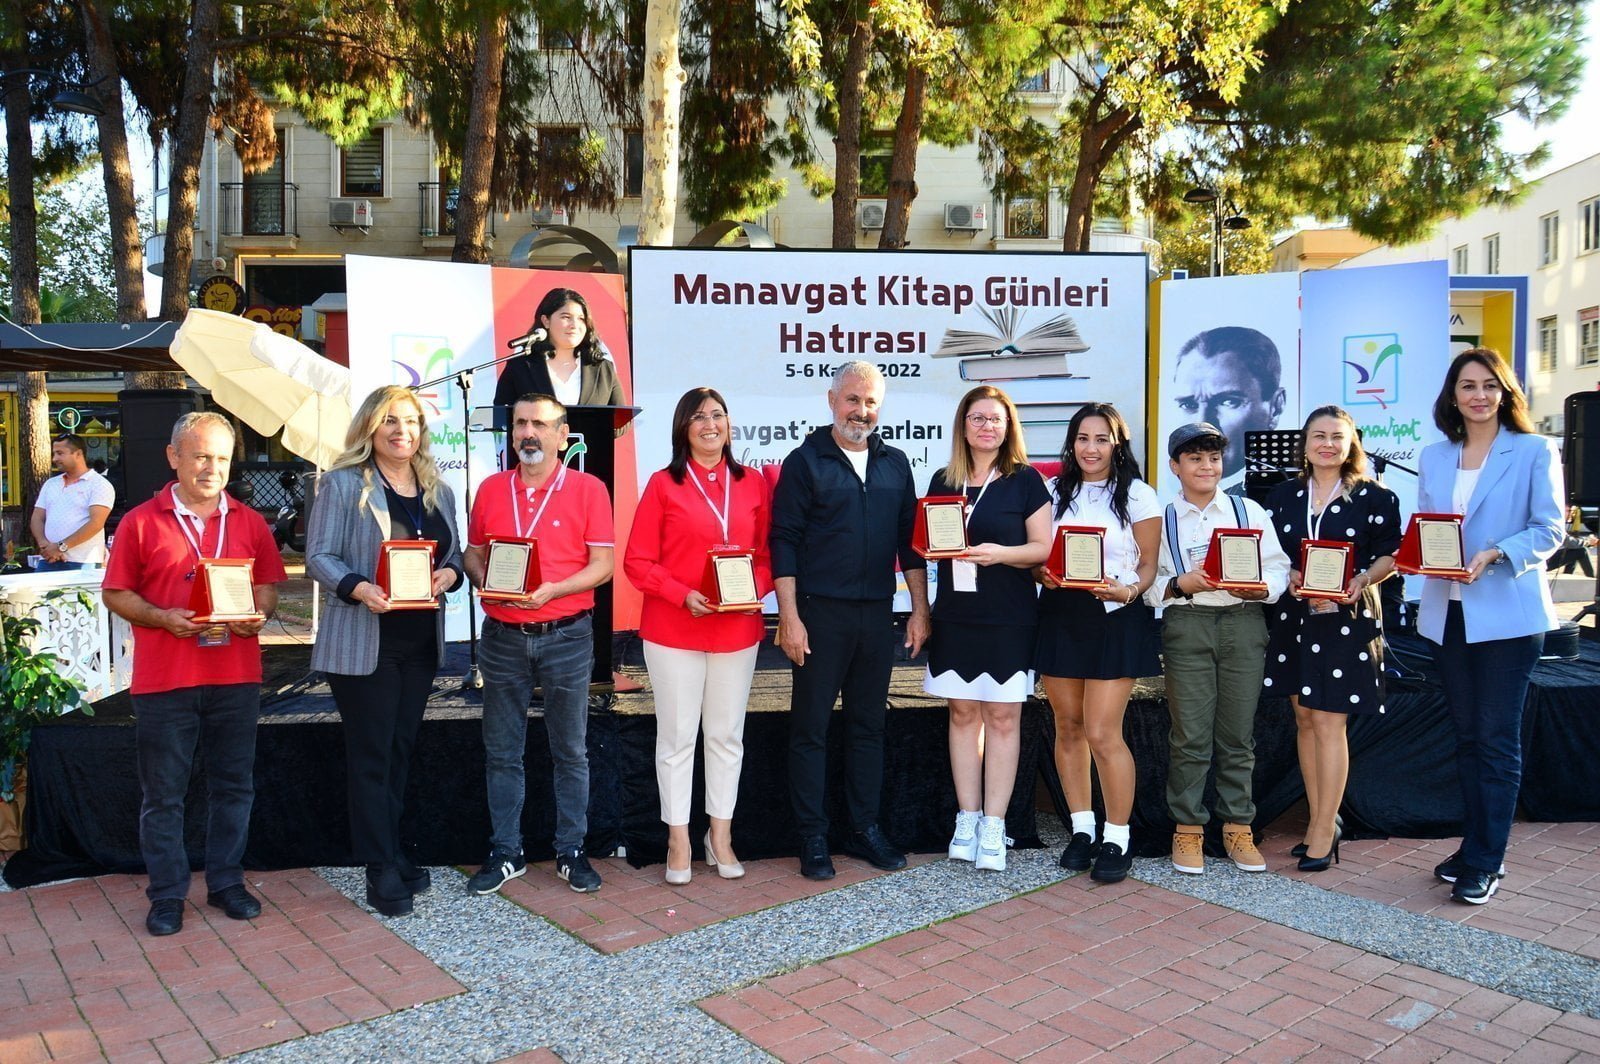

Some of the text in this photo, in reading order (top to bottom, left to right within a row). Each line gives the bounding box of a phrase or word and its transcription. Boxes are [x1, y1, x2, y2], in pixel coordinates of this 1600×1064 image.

[674, 273, 1109, 314] Manavgat Kitap Günleri
[780, 323, 926, 354] Hatırası
[785, 363, 814, 377] 5-6
